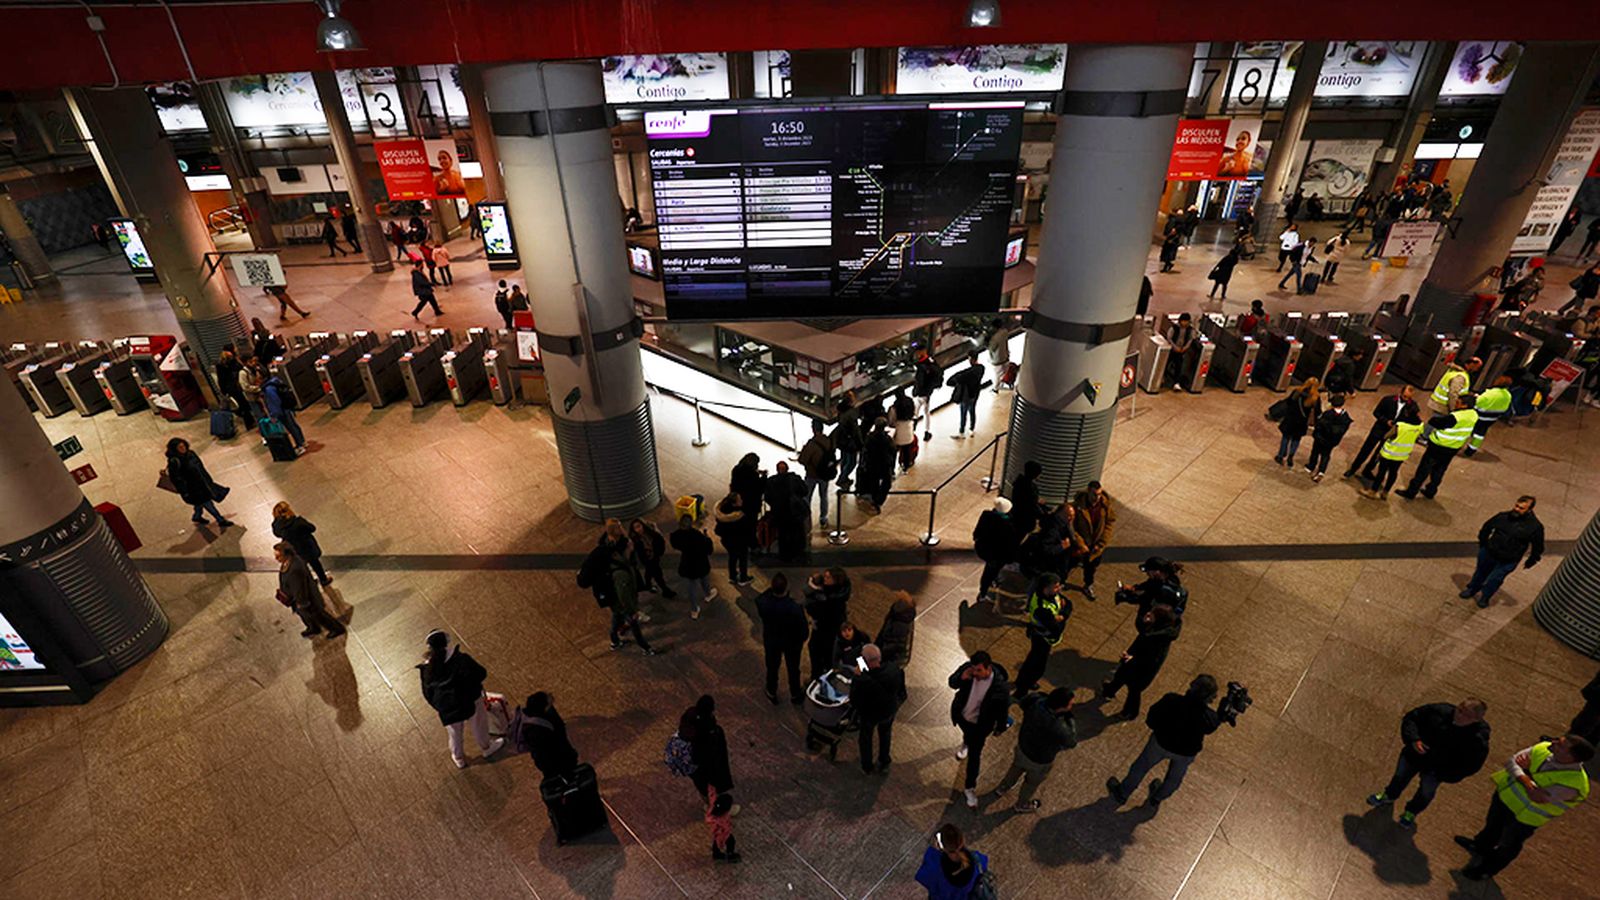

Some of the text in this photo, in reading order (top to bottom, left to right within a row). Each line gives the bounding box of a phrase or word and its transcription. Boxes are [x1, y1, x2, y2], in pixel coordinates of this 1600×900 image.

[973, 75, 1023, 89] Contigo
[1201, 69, 1222, 106] 7
[1238, 68, 1262, 105] 8
[1317, 73, 1361, 89] ontigo
[637, 84, 686, 98] Contigo
[373, 92, 397, 128] 3
[416, 90, 438, 126] 4
[649, 116, 686, 130] renfe
[771, 121, 804, 134] 16:50
[1182, 128, 1221, 136] DISCULPEN
[1176, 136, 1222, 145] LAS MEJORAS
[382, 150, 419, 158] DISCULPEN
[650, 148, 685, 158] Cercanías
[381, 157, 425, 166] LAS MEJORAS
[662, 258, 683, 266] Media
[689, 257, 709, 266] Larga
[710, 256, 741, 265] Distancia
